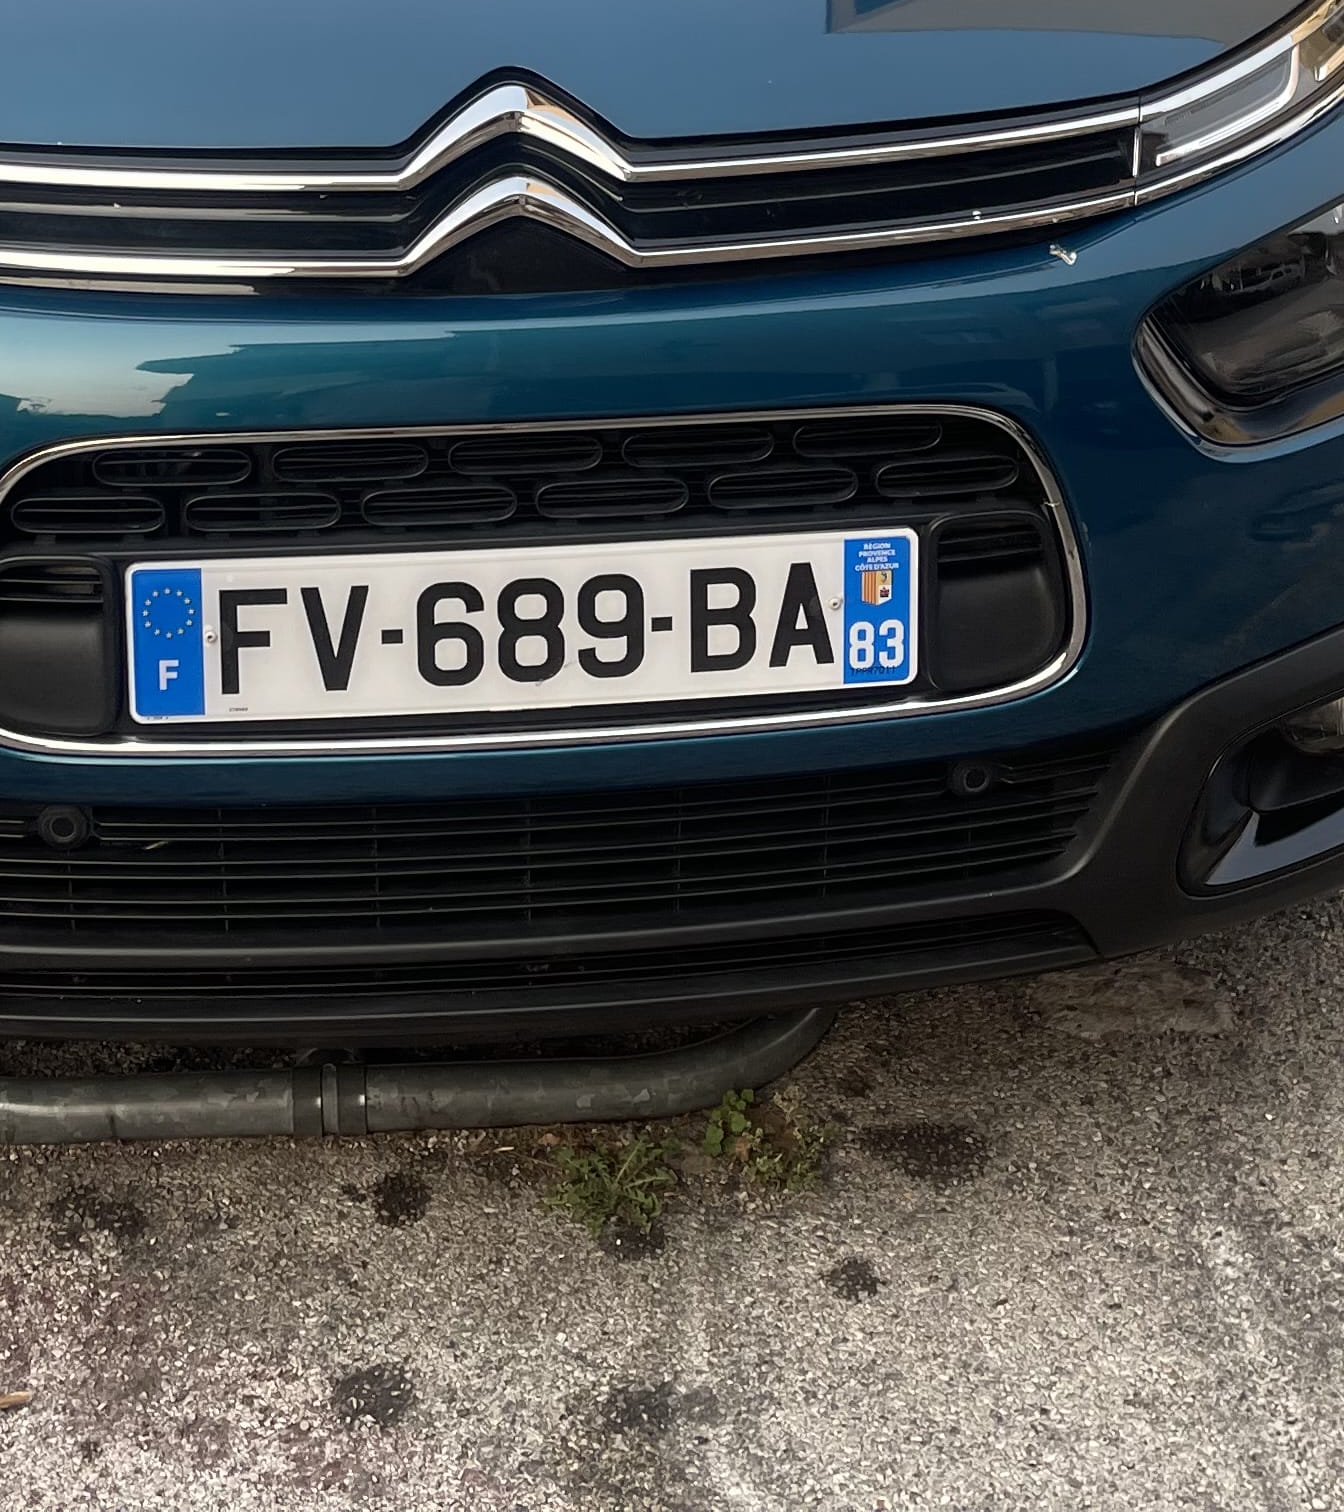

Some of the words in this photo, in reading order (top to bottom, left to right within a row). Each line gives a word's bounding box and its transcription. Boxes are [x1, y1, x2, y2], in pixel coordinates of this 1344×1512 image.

[858, 549, 896, 558] PROVENCE
[218, 561, 835, 695] FV-689-BA
[849, 619, 905, 670] 83
[158, 659, 180, 691] F
